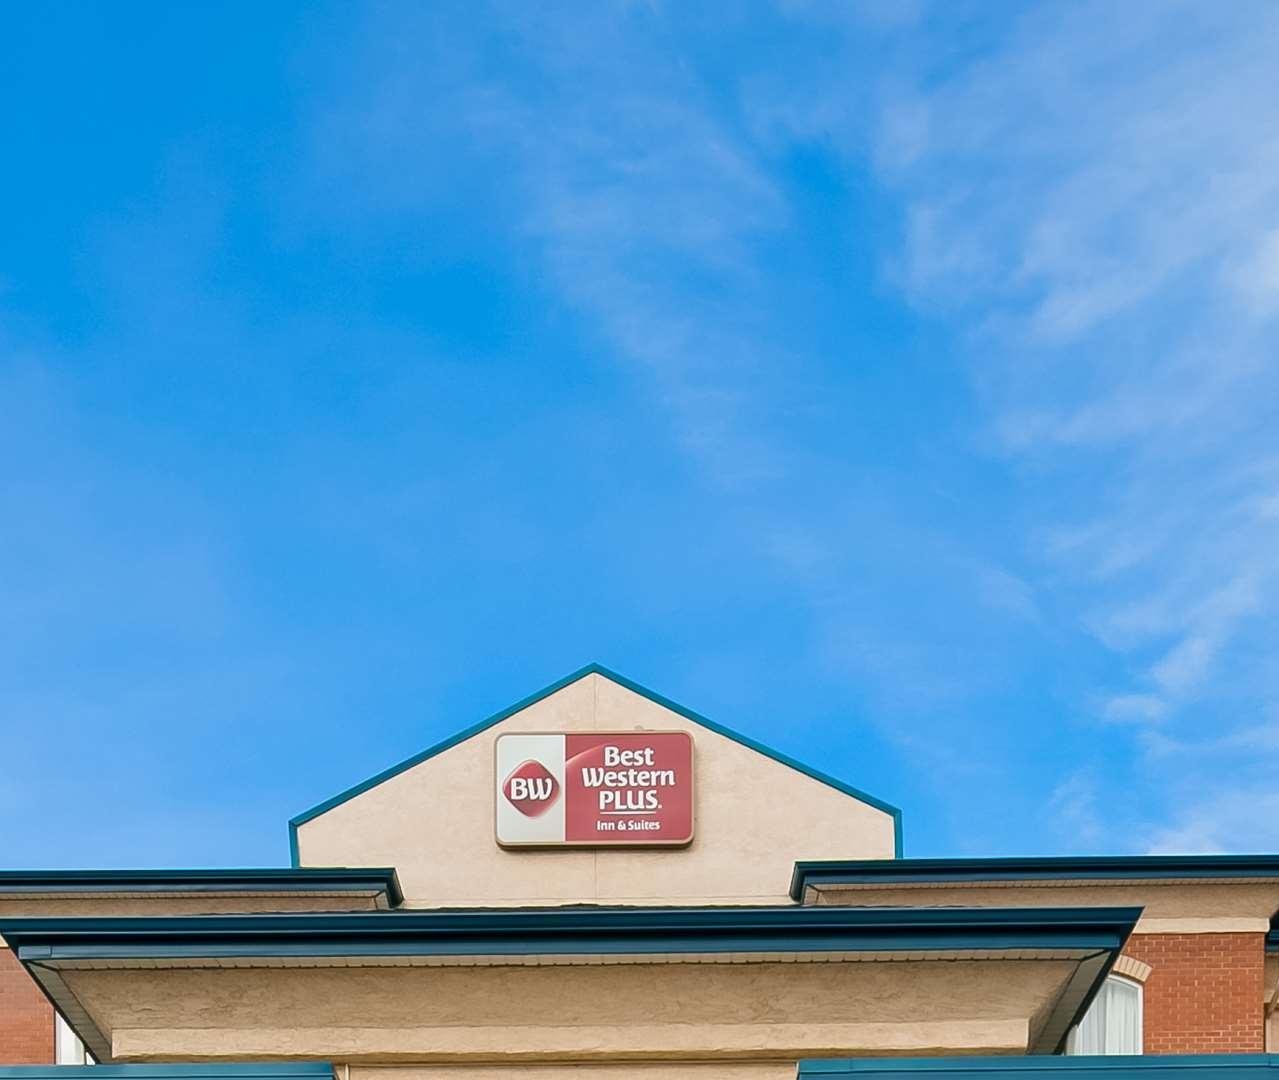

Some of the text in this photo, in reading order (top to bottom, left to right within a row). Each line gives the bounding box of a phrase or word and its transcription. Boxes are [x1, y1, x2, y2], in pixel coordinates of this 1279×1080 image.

[604, 746, 654, 767] Best
[582, 767, 676, 787] Western
[510, 777, 553, 801] BW
[596, 819, 661, 831] Inn & Suites
